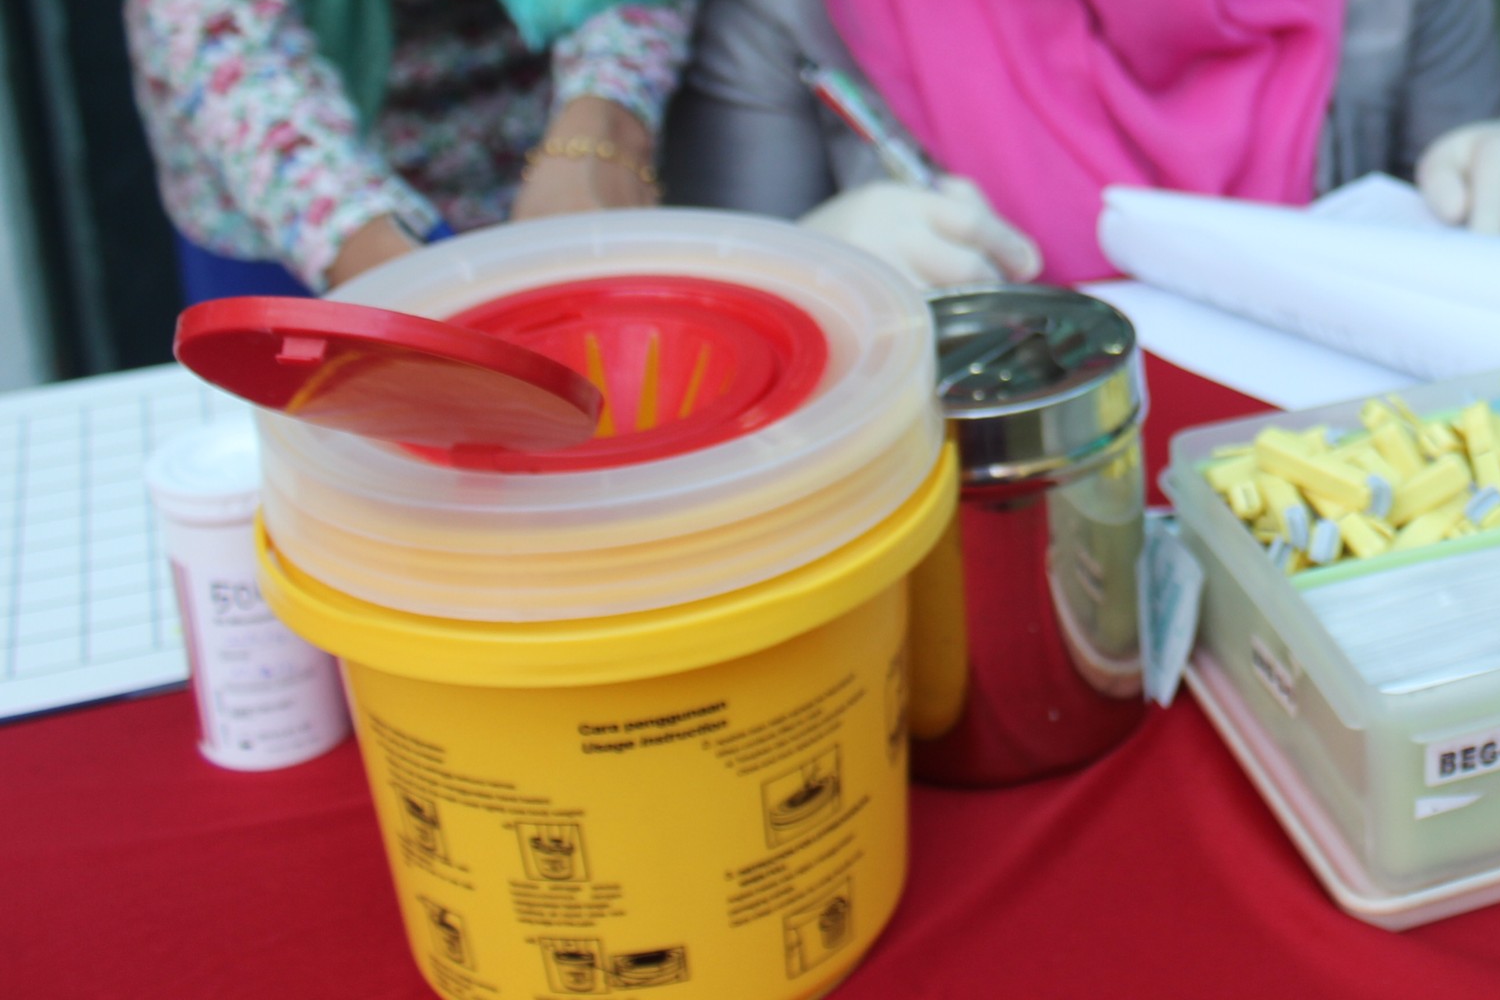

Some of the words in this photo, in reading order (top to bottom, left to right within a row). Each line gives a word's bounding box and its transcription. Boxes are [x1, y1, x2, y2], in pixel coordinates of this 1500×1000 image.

[578, 721, 620, 737] Cara
[581, 739, 636, 755] Usage
[639, 718, 728, 747] instruction
